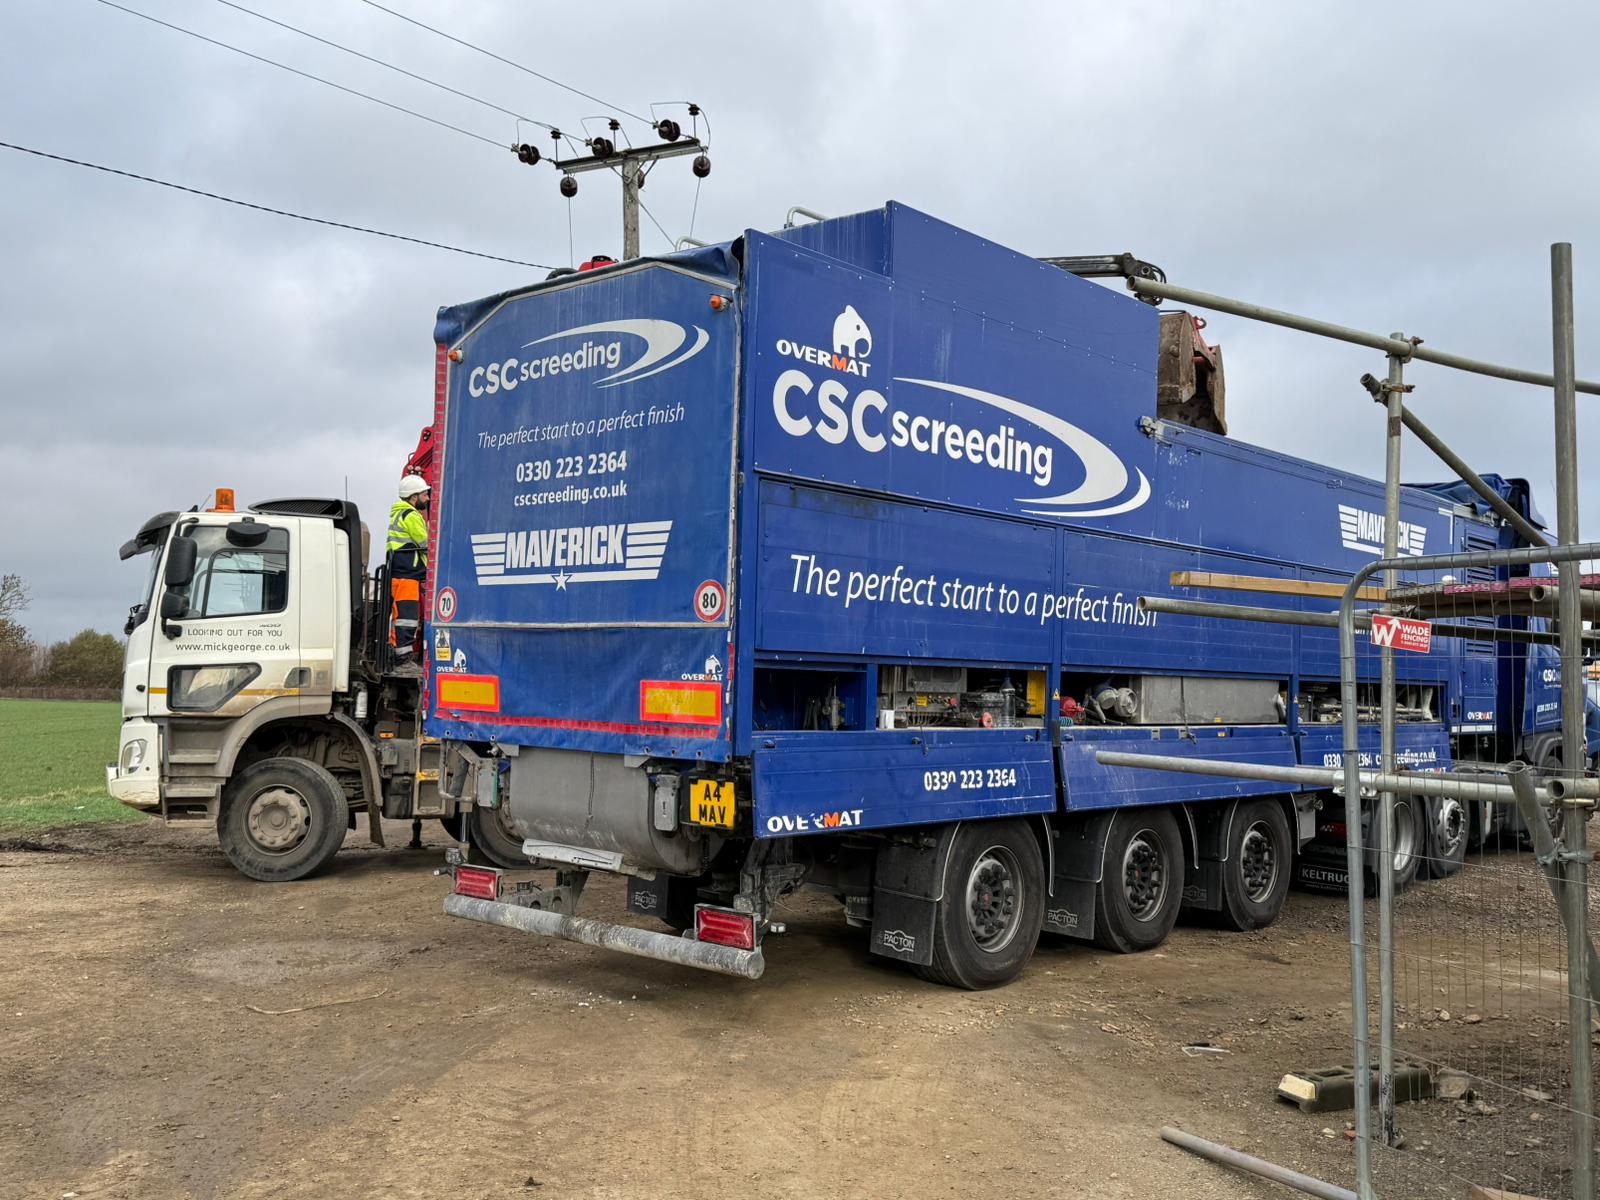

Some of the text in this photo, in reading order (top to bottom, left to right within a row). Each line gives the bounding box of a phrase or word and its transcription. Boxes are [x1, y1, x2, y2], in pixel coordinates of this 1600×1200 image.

[776, 339, 871, 378] OVERMAT
[468, 341, 621, 398] CSC screeding
[478, 401, 685, 450] The perfect start to a perfect finish
[772, 369, 1053, 487] CSC screeding
[516, 450, 628, 483] 0330 223 2364
[514, 479, 628, 507] cscscreeding.co.uk
[505, 523, 626, 569] MAVERICK
[790, 554, 841, 597] The
[845, 565, 934, 608] perfect
[940, 576, 993, 613] start
[998, 583, 1019, 615] to
[1025, 591, 1038, 617] a
[1041, 588, 1109, 626] perfect
[441, 597, 452, 612] 70
[702, 592, 717, 609] 80
[187, 628, 283, 637] LOOKING OUT FOR YOU
[1400, 633, 1428, 644] FENCING
[1401, 624, 1429, 636] WADE
[175, 642, 290, 653] www.mickgeorge.co.uk
[681, 673, 723, 681] OVERMAT
[1323, 753, 1341, 767] 0330
[960, 769, 983, 789] 223
[704, 783, 722, 802] A4
[699, 804, 726, 824] MAV
[1302, 867, 1350, 884] KELTRUC
[1048, 912, 1078, 925] PACTON
[884, 933, 915, 949] PACTON
